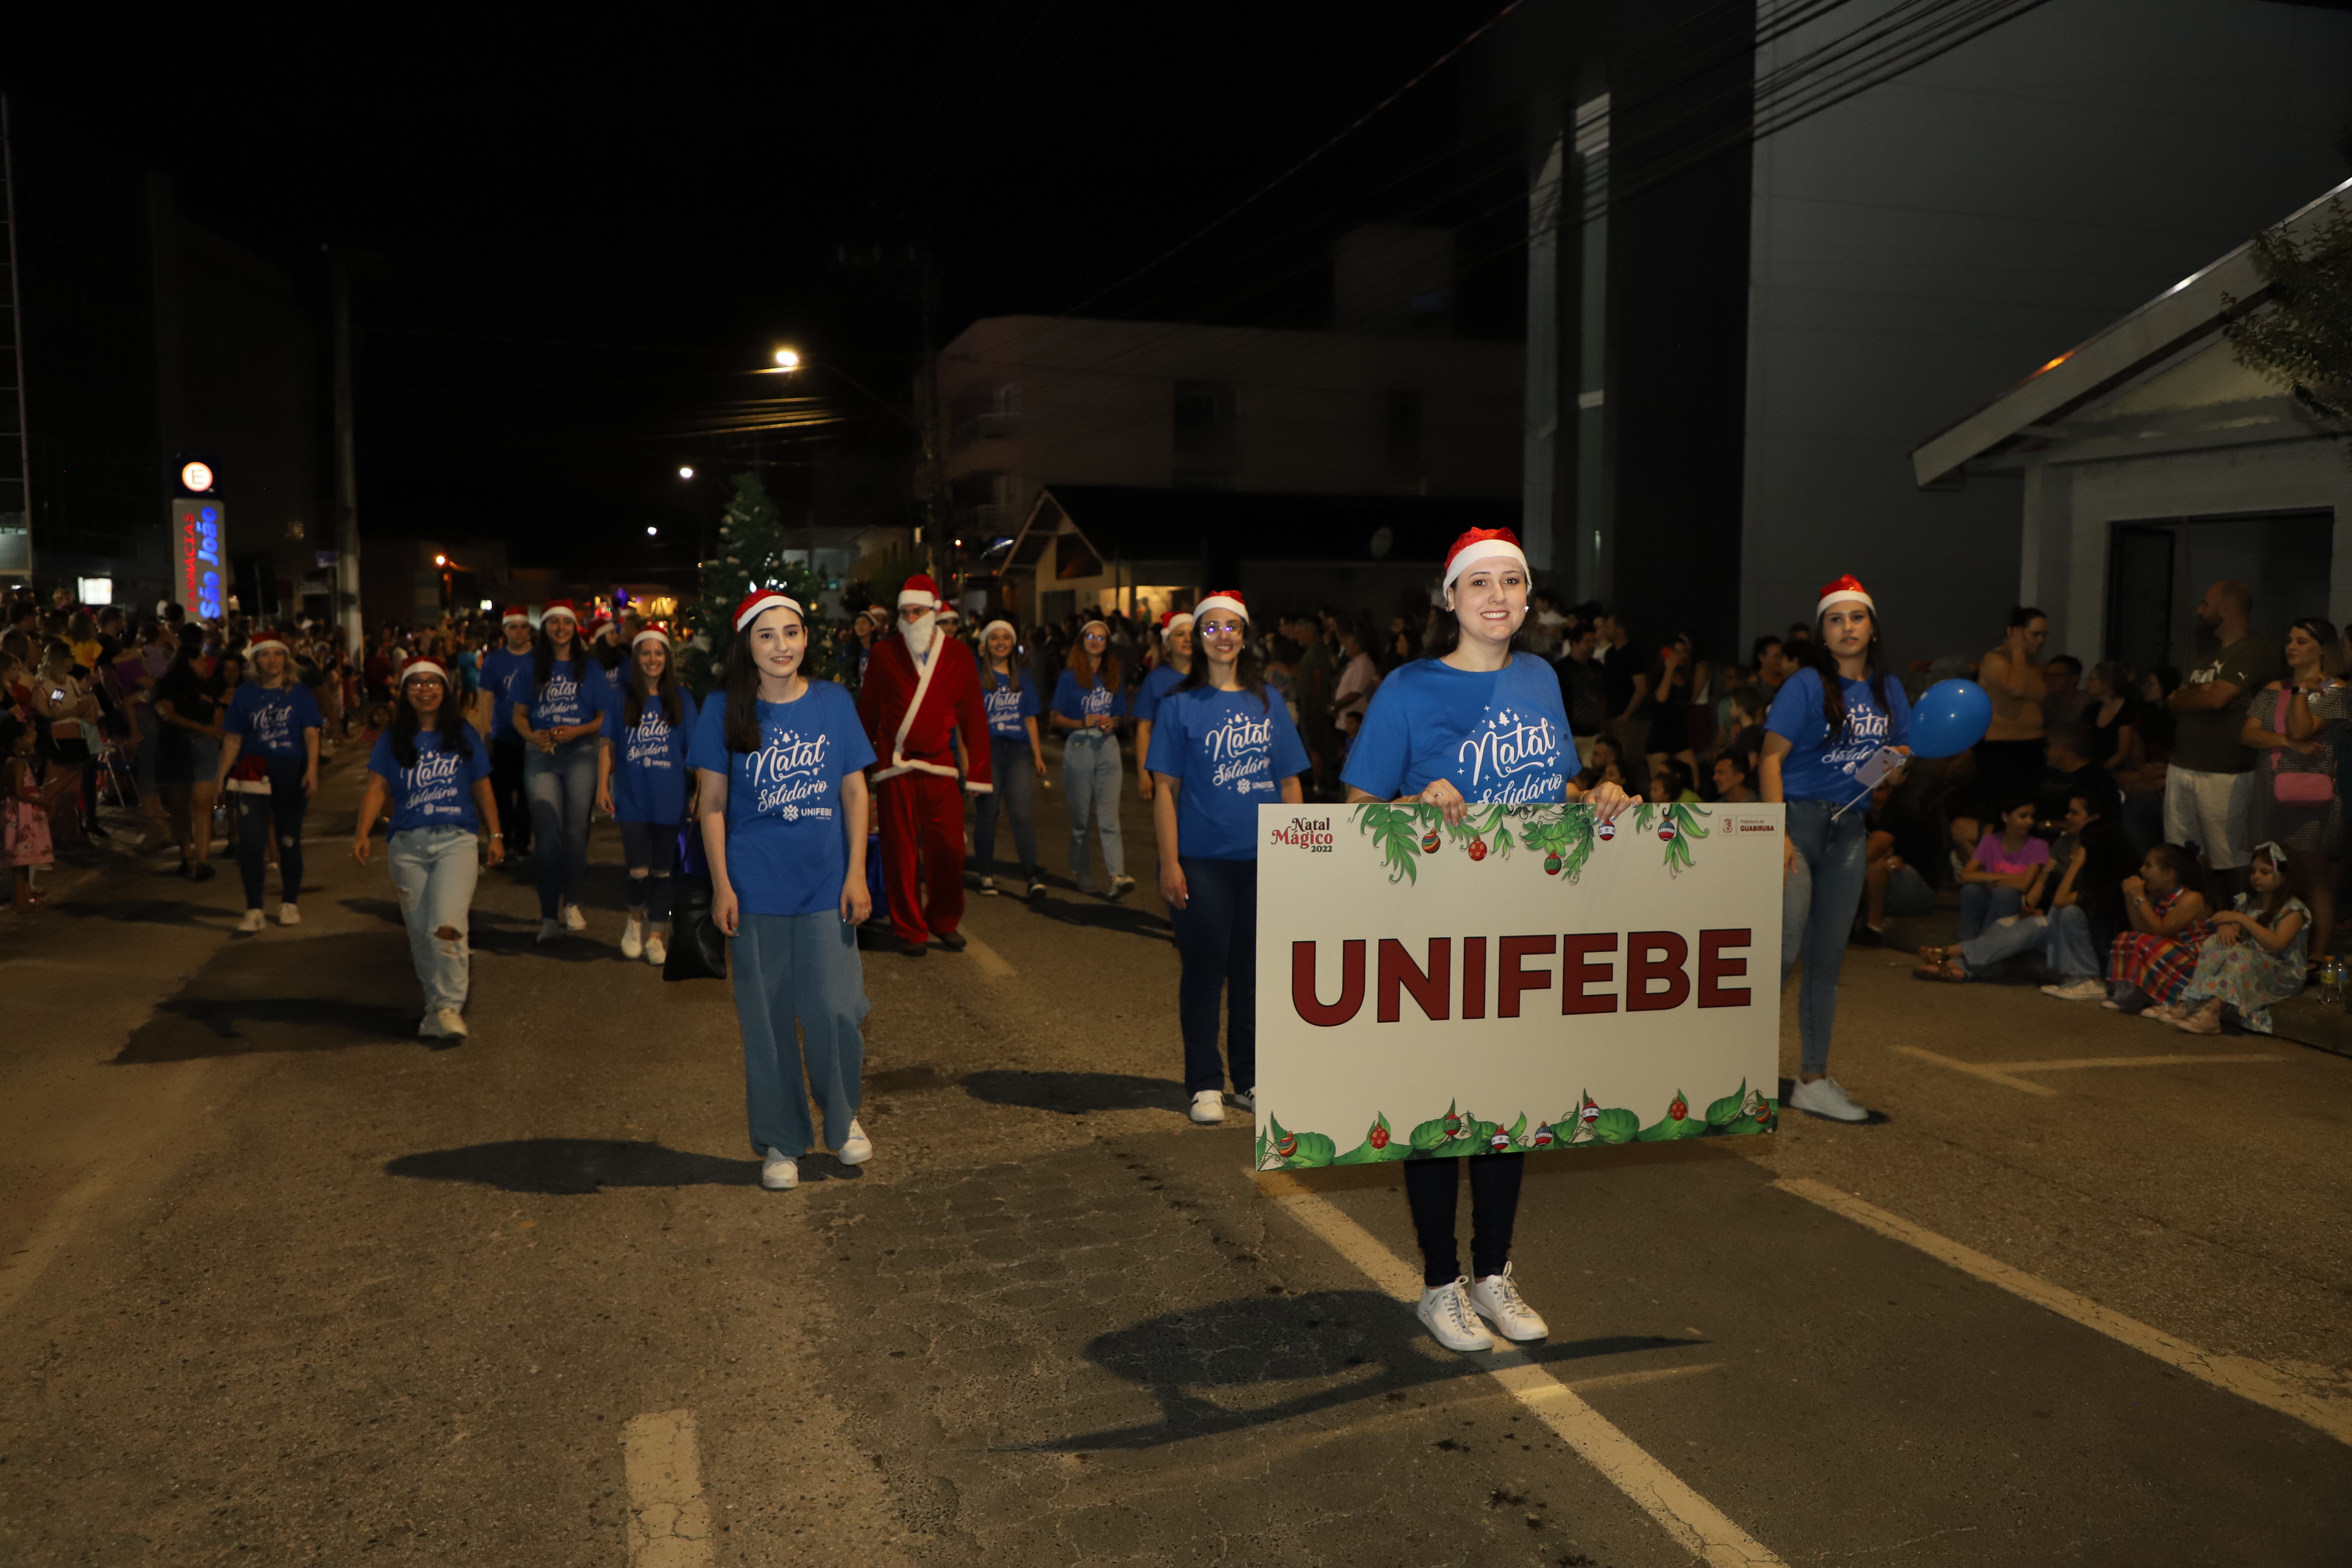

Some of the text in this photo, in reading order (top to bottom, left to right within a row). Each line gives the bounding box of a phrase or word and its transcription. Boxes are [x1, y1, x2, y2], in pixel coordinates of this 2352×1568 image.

[196, 507, 221, 619] São João
[758, 779, 828, 812] Solidário
[1271, 826, 1333, 849] Mágico
[1291, 817, 1330, 832] Natal
[1291, 928, 1752, 1027] UNIFEBE
